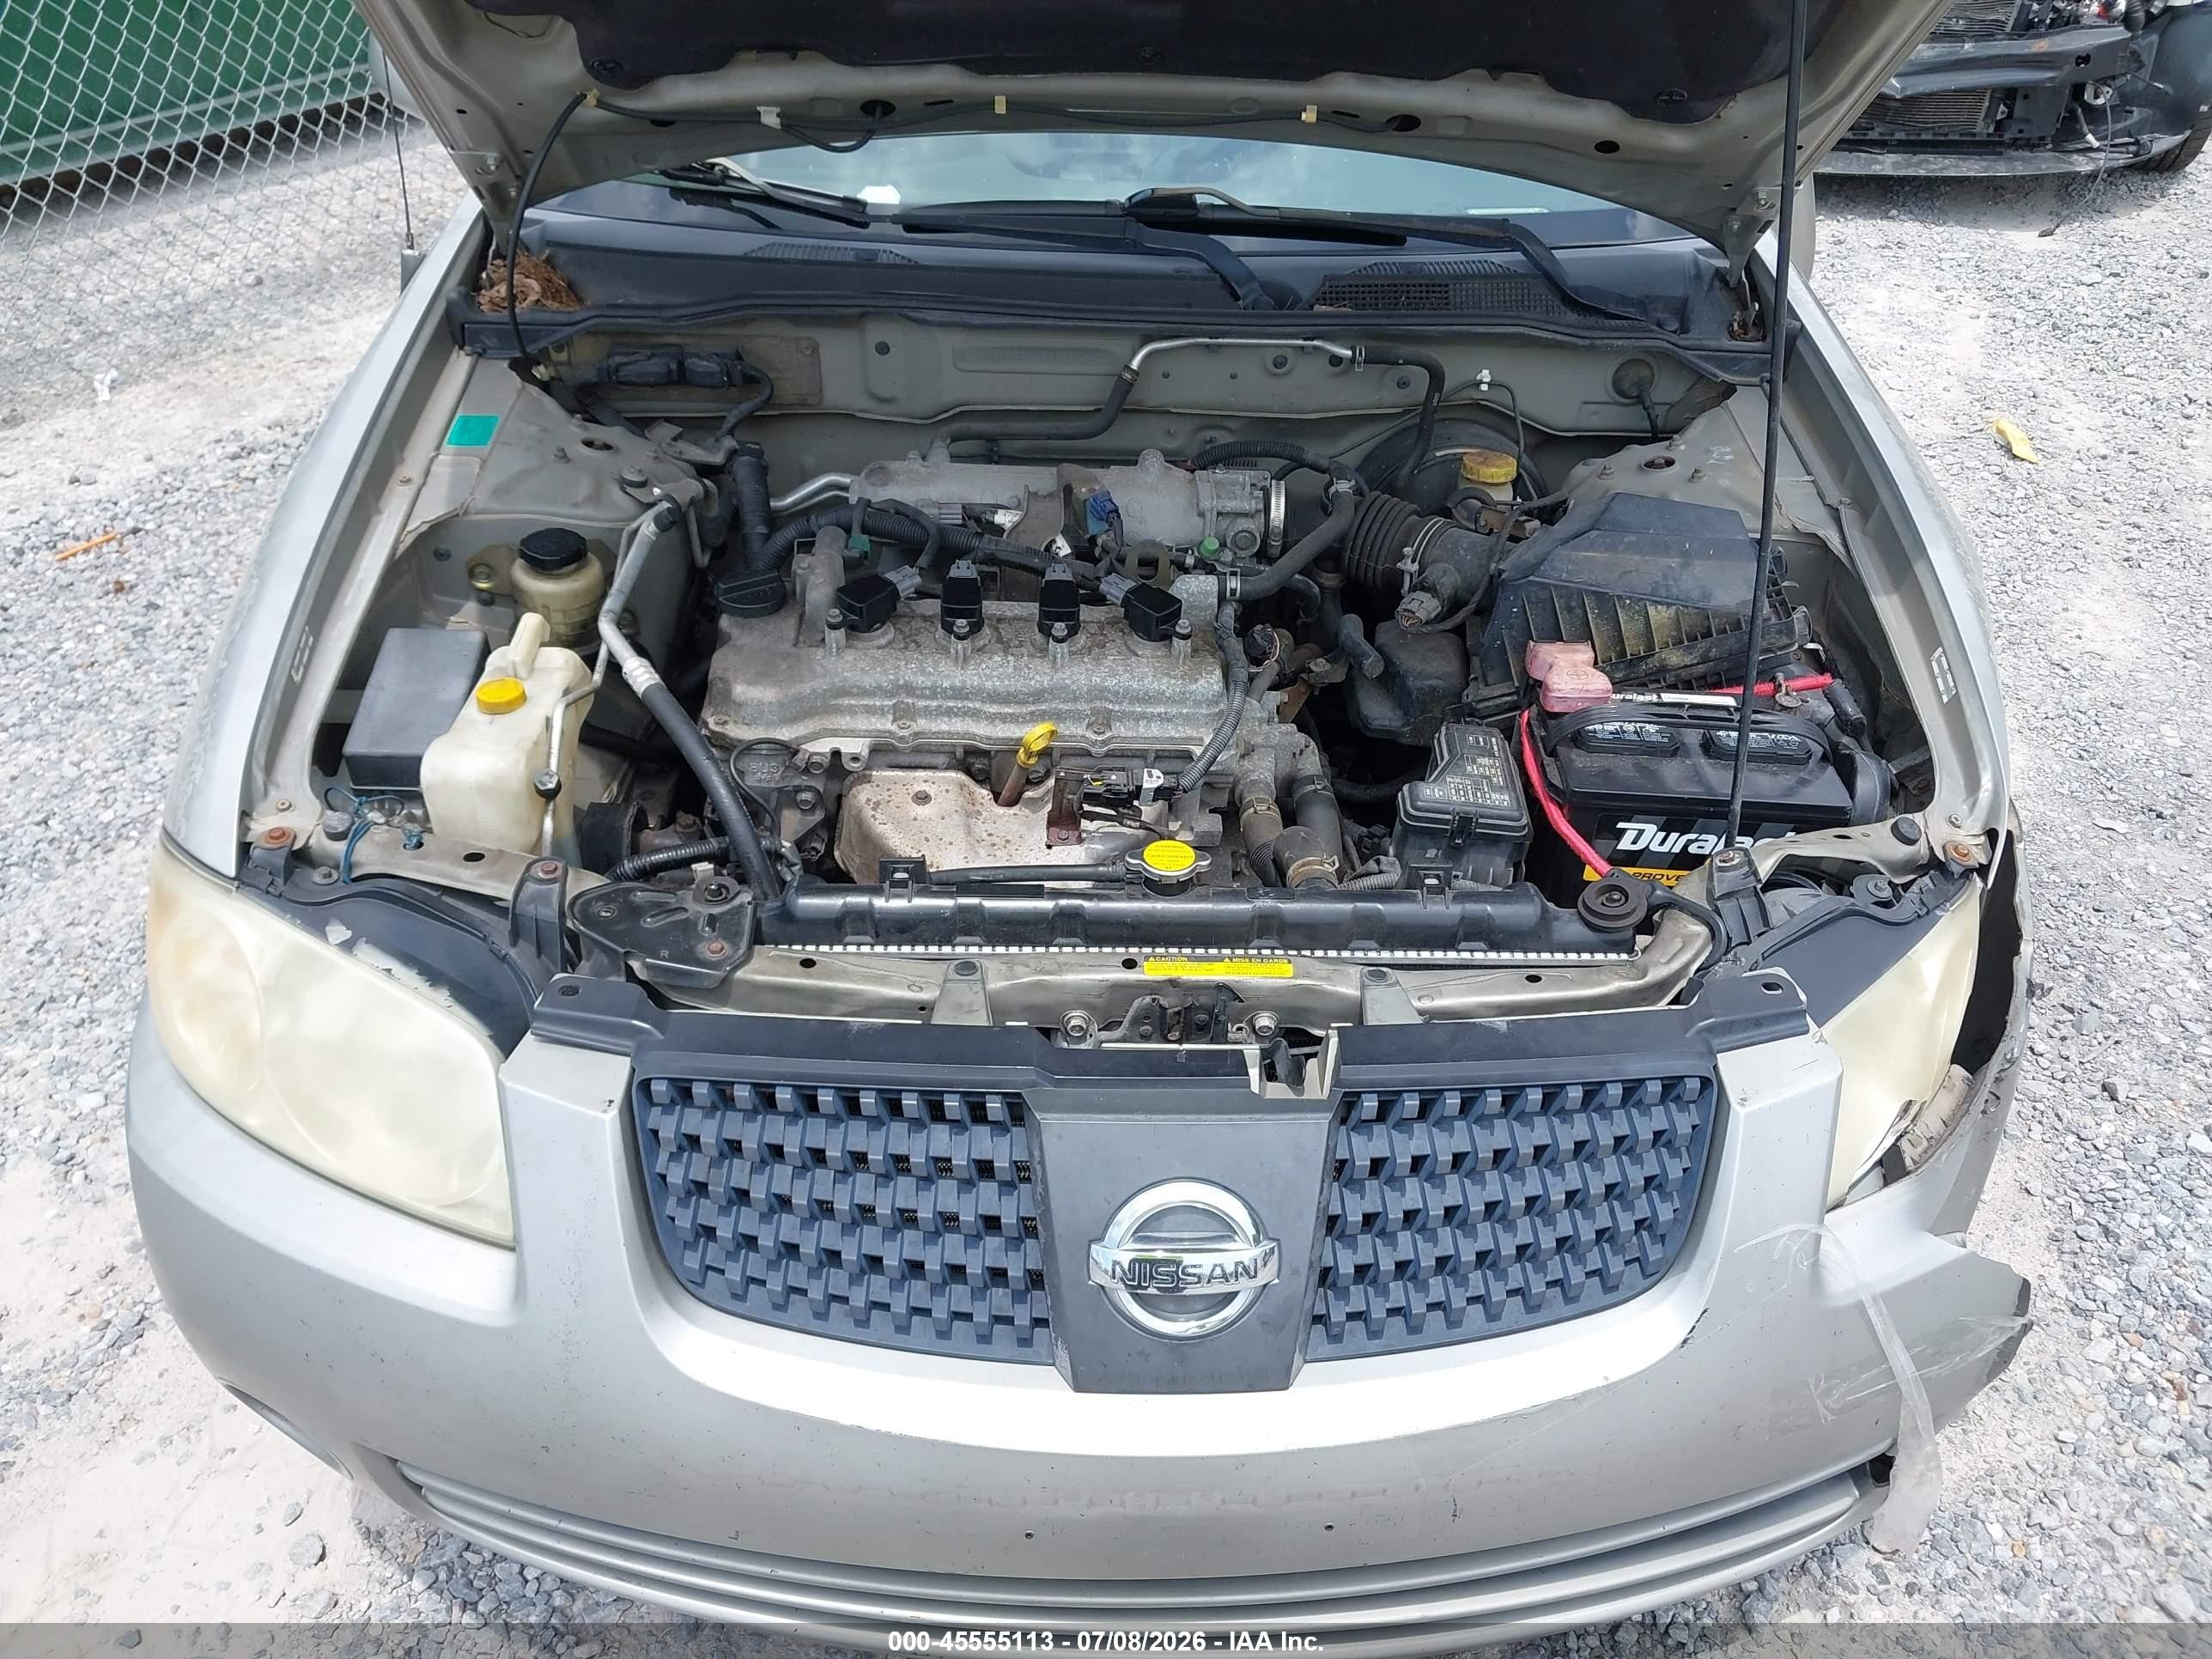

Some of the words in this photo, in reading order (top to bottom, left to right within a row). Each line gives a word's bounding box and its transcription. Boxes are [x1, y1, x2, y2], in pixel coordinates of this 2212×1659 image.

[1611, 693, 1659, 702] uralast
[1615, 822, 1796, 856] Dural
[1632, 872, 1686, 882] PROVE
[1110, 1258, 1258, 1287] NISSAN
